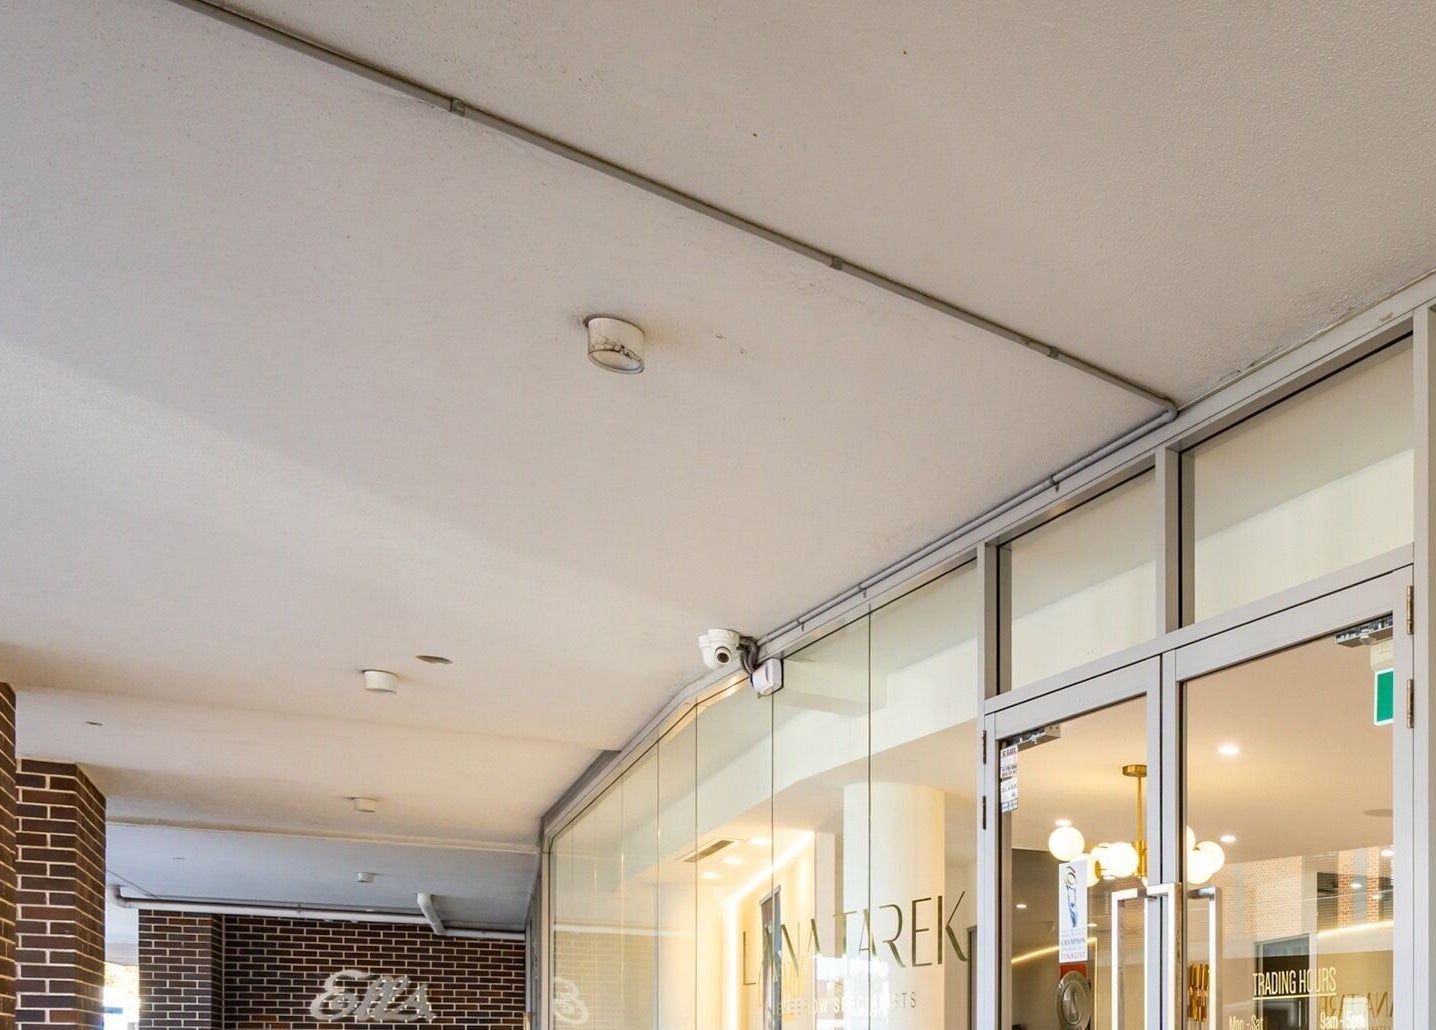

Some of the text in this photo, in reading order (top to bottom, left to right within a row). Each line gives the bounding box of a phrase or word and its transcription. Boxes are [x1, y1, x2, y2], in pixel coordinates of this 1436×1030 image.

[1252, 967, 1337, 996] TRADING HOURS
[1320, 1011, 1339, 1030] 9am
